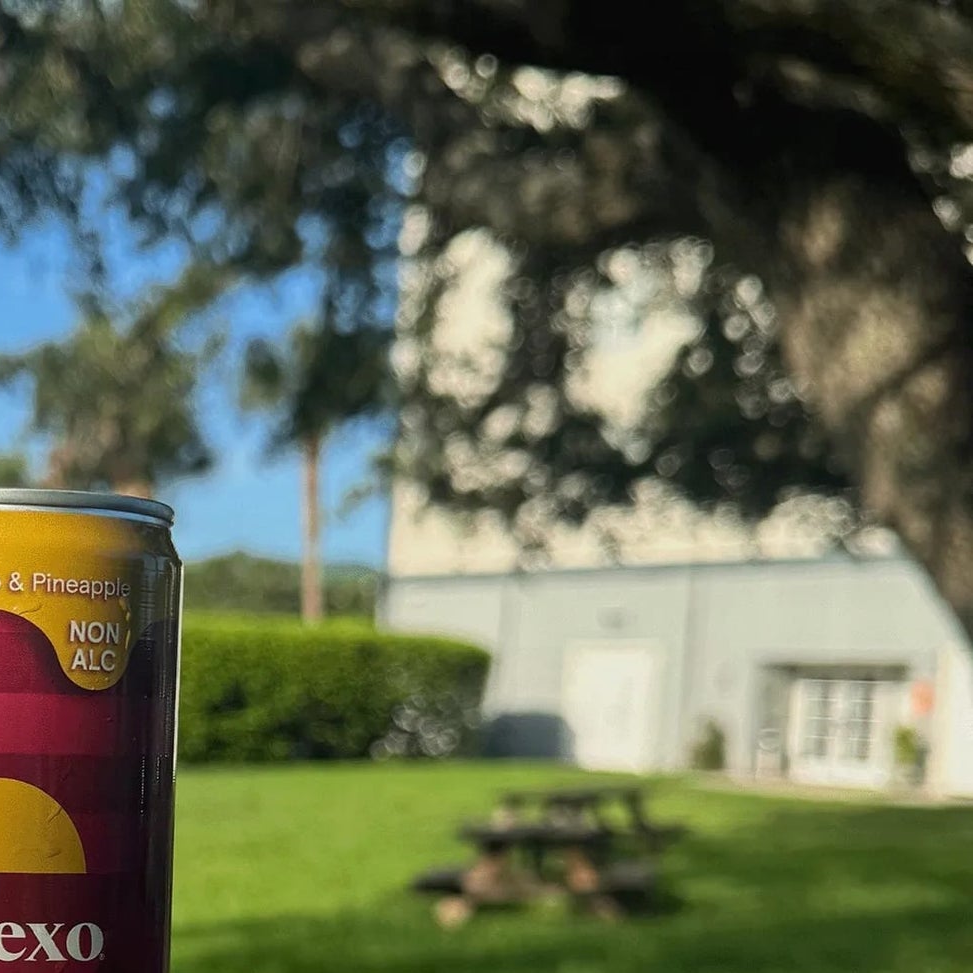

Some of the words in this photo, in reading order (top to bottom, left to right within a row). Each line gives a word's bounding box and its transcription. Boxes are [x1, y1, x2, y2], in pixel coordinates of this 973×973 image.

[9, 573, 24, 591] &
[32, 573, 131, 600] Pineapple
[69, 620, 120, 645] NON
[71, 649, 116, 672] ALC
